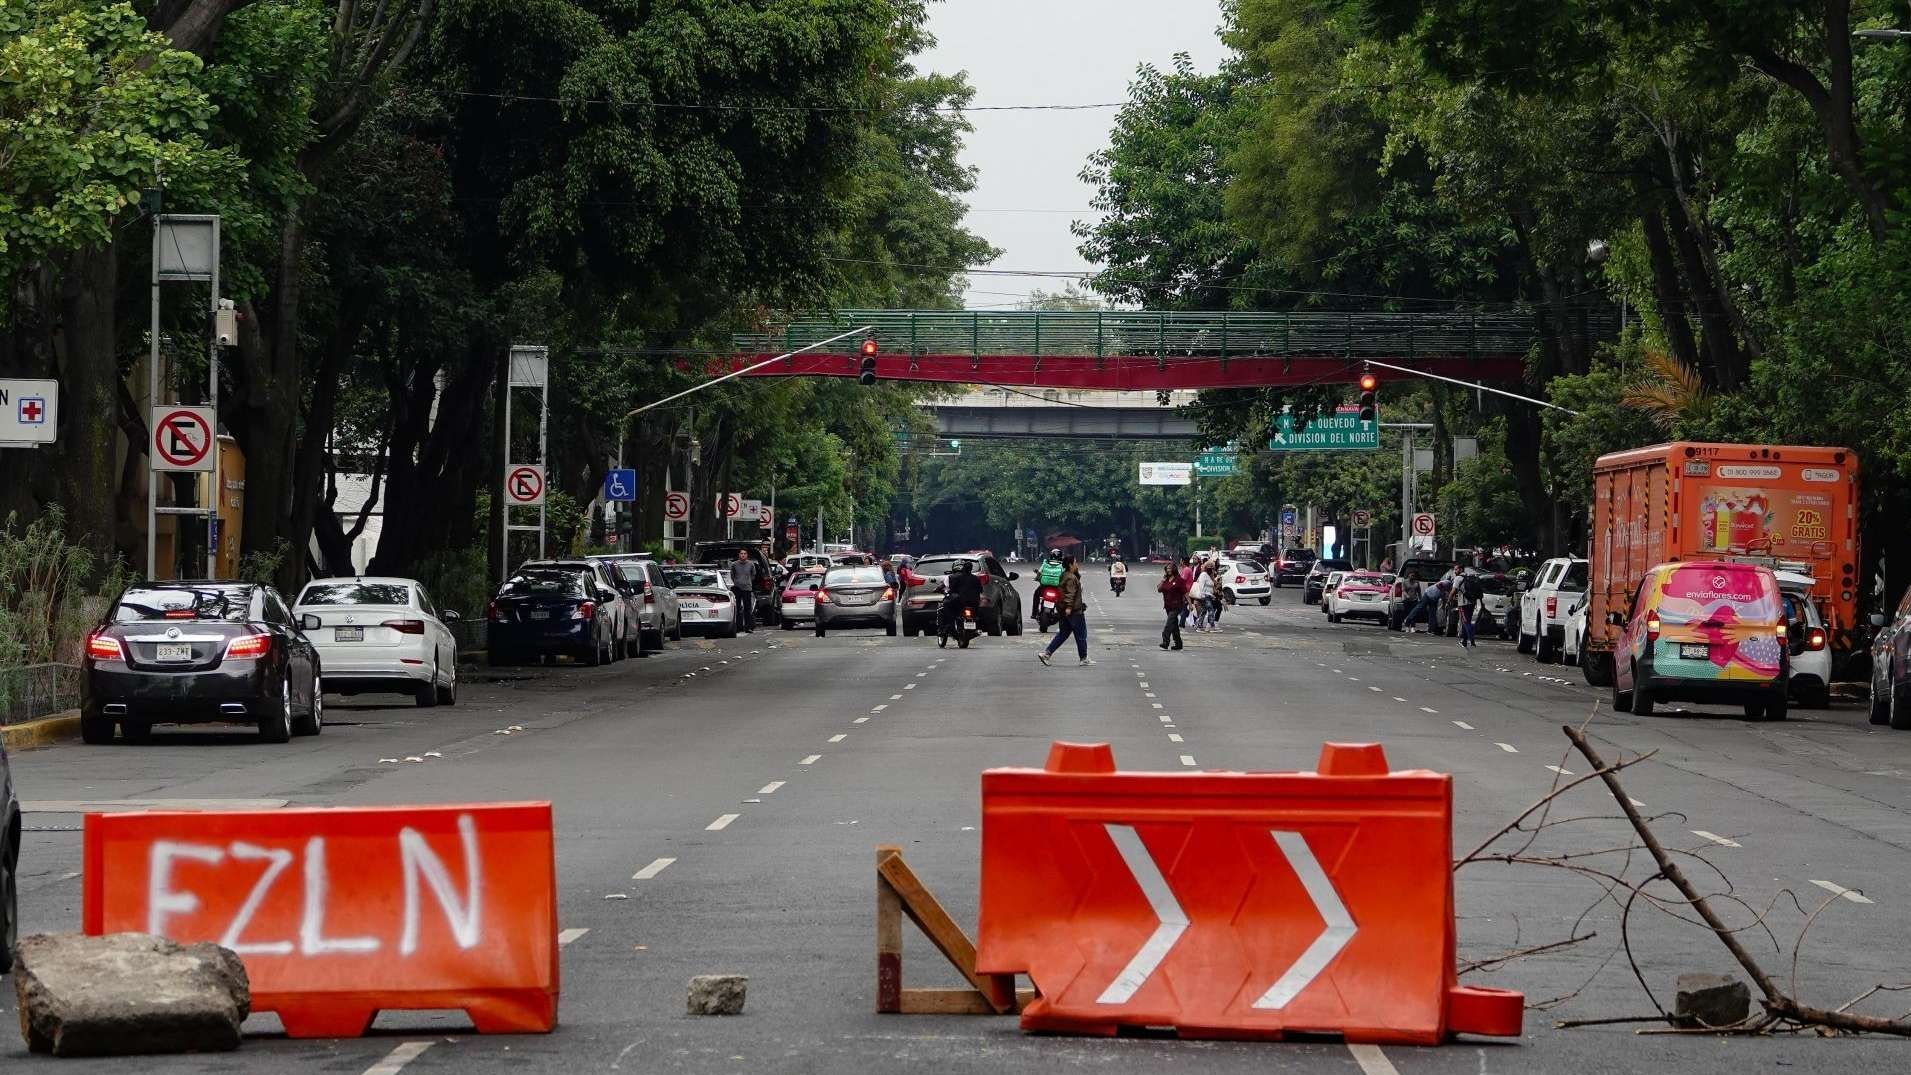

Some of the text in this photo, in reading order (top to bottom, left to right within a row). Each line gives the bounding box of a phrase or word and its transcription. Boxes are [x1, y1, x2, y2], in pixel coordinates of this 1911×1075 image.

[1317, 418, 1355, 428] QUEVEDO
[1289, 432, 1375, 443] DIVISION DEL NORTE
[1695, 447, 1720, 456] 9117
[1798, 510, 1820, 524] 20%
[1792, 526, 1825, 538] GRATIS
[1686, 590, 1752, 600] enviaflores.com
